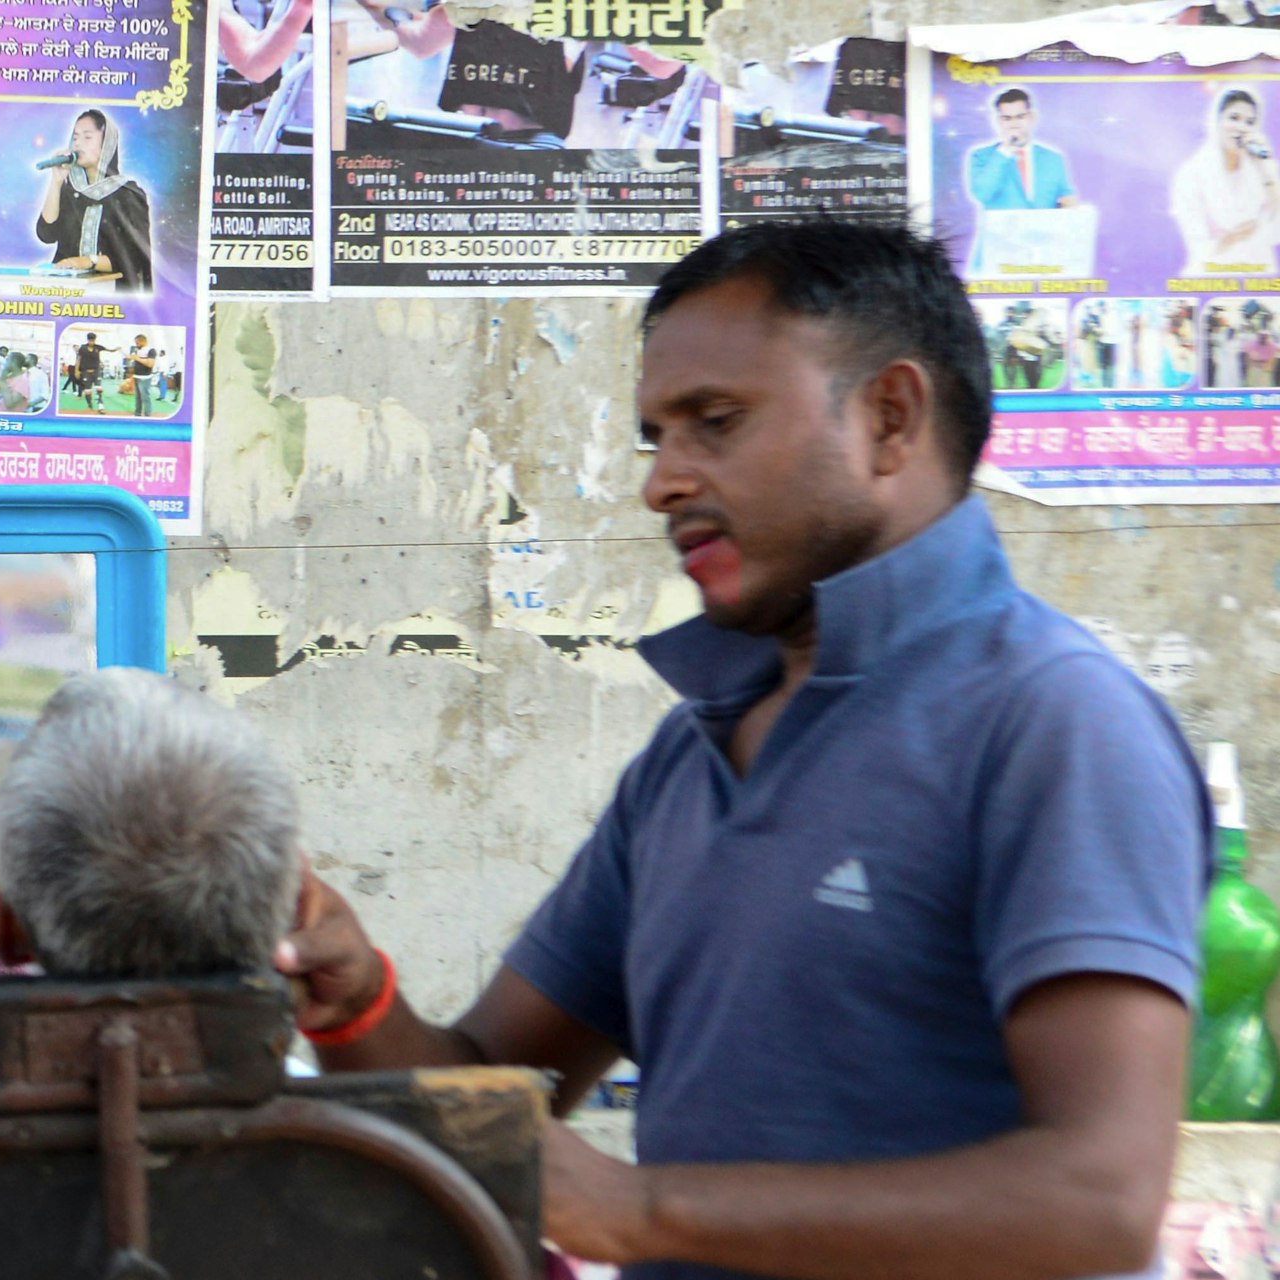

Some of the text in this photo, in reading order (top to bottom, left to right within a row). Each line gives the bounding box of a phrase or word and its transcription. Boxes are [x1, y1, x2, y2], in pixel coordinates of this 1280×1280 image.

[120, 18, 169, 36] 100%
[74, 40, 90, 59] ਵੀ
[347, 172, 397, 186] Gyming
[415, 172, 476, 184] Personal
[478, 171, 535, 186] Training
[214, 191, 256, 204] Kettle
[366, 188, 396, 200] Kick
[455, 188, 499, 200] Power
[258, 217, 312, 236] AMRITSAR
[337, 213, 376, 235] 2nd
[333, 241, 381, 263] Floor
[427, 266, 627, 284] www.vigorousfitness.in
[19, 284, 85, 298] Worshiper
[49, 302, 126, 320] SAMUEL
